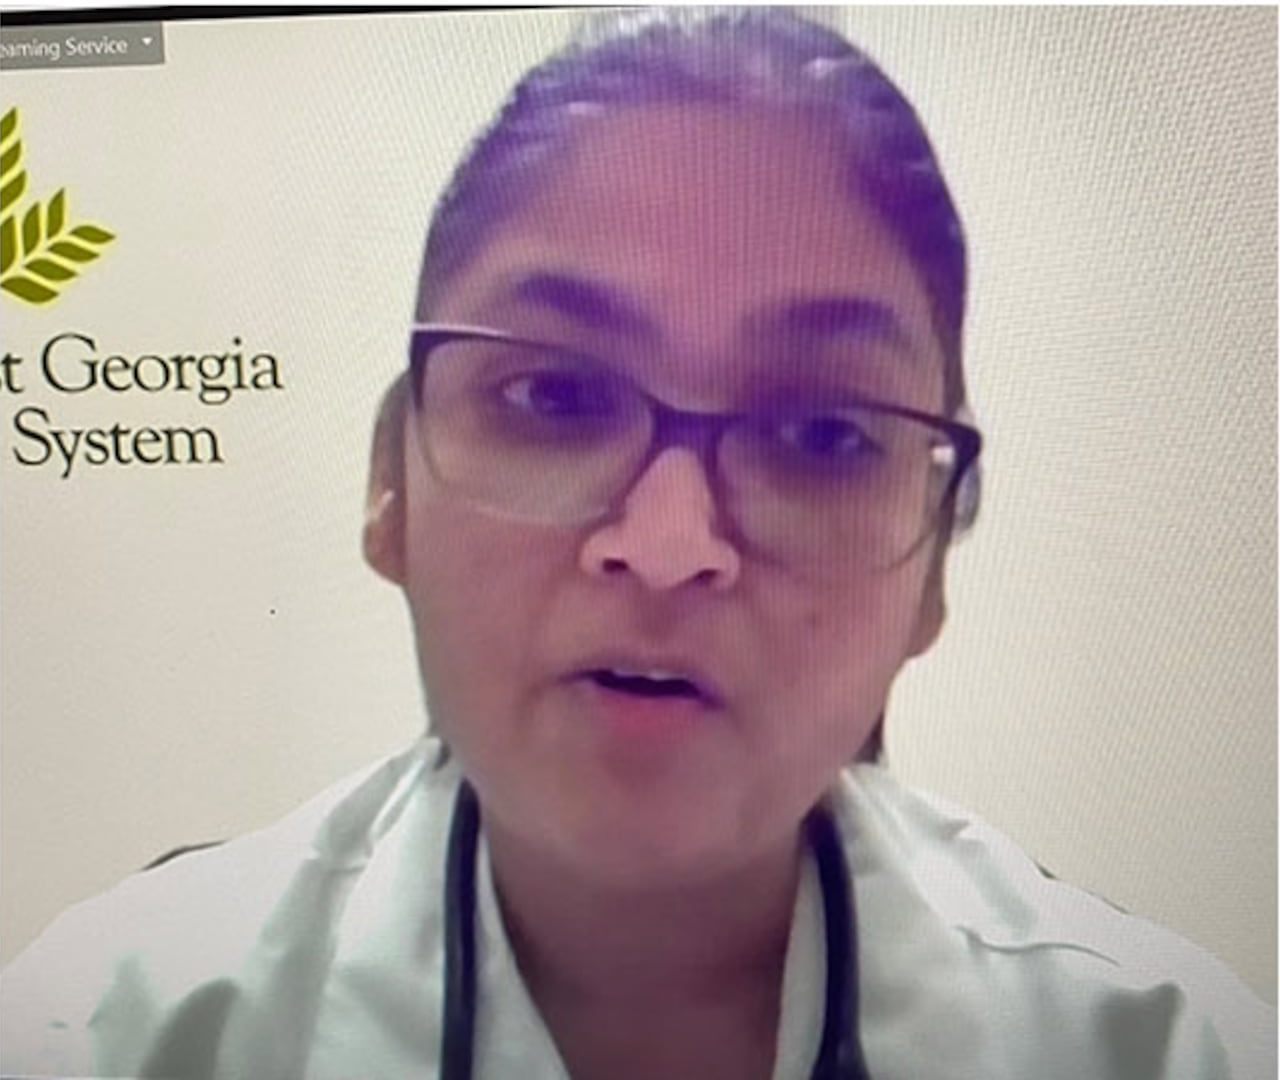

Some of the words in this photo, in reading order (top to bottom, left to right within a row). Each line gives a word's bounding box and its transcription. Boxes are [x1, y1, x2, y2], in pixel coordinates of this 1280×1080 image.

[65, 35, 128, 57] Service
[41, 332, 284, 406] Georgia
[12, 406, 224, 480] System
